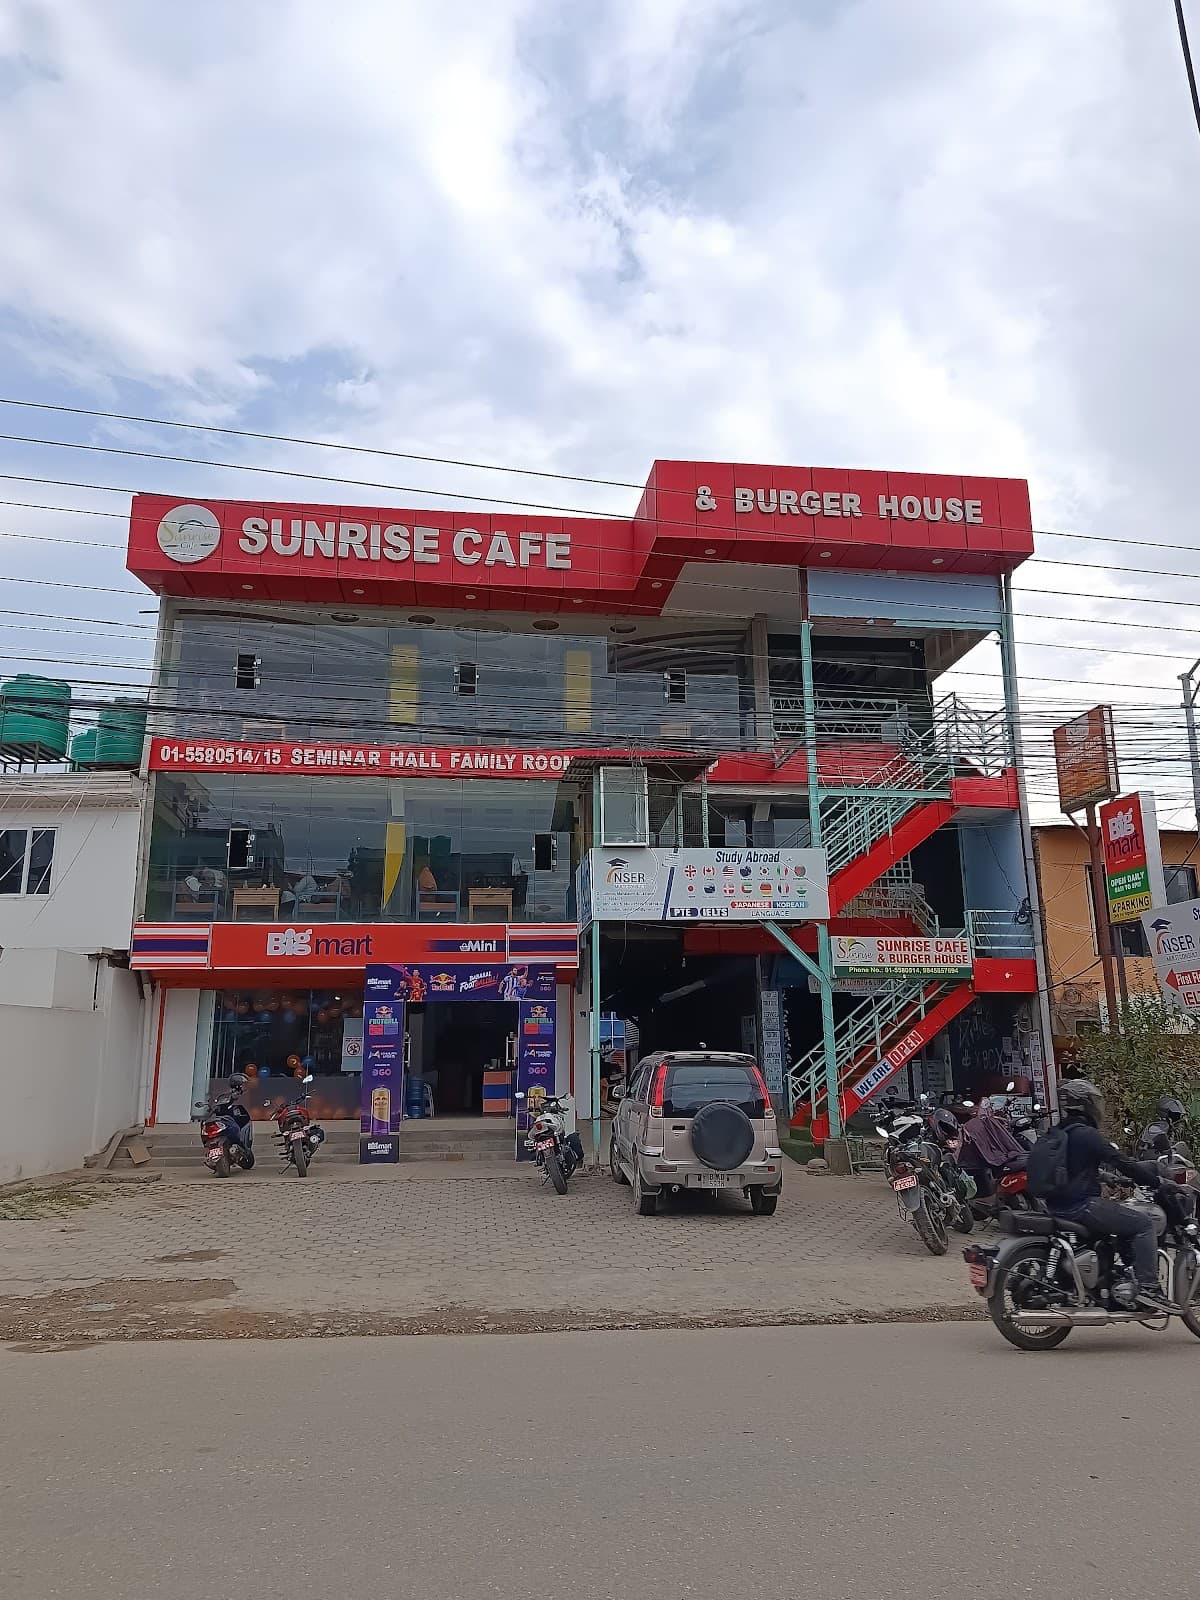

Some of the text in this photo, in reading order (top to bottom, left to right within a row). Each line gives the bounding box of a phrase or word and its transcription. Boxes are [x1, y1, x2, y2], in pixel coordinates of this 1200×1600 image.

[695, 485, 984, 524] & BURGER HOUSE
[238, 517, 572, 569] SUNRISE CAFE
[160, 745, 282, 765] 01-5580514/15
[290, 748, 380, 766] SEMINAR
[390, 752, 442, 768] HALL
[450, 753, 517, 770] FAMILY
[1108, 807, 1135, 841] Big
[1107, 832, 1141, 859] mart
[715, 850, 780, 865] Study Abroad
[614, 872, 646, 883] NSER
[1111, 871, 1145, 888] OPEN DAILY
[673, 908, 728, 917] PTE IELTS
[1117, 895, 1150, 913] PARKING
[267, 928, 373, 957] Big mart
[467, 940, 497, 953] Mini
[876, 940, 968, 952] SUNRISE CAFE
[1161, 935, 1195, 954] NSER
[877, 953, 969, 964] & BURGER HOUSE
[1176, 972, 1192, 986] First
[857, 1030, 922, 1096] WE ARE OPEN
